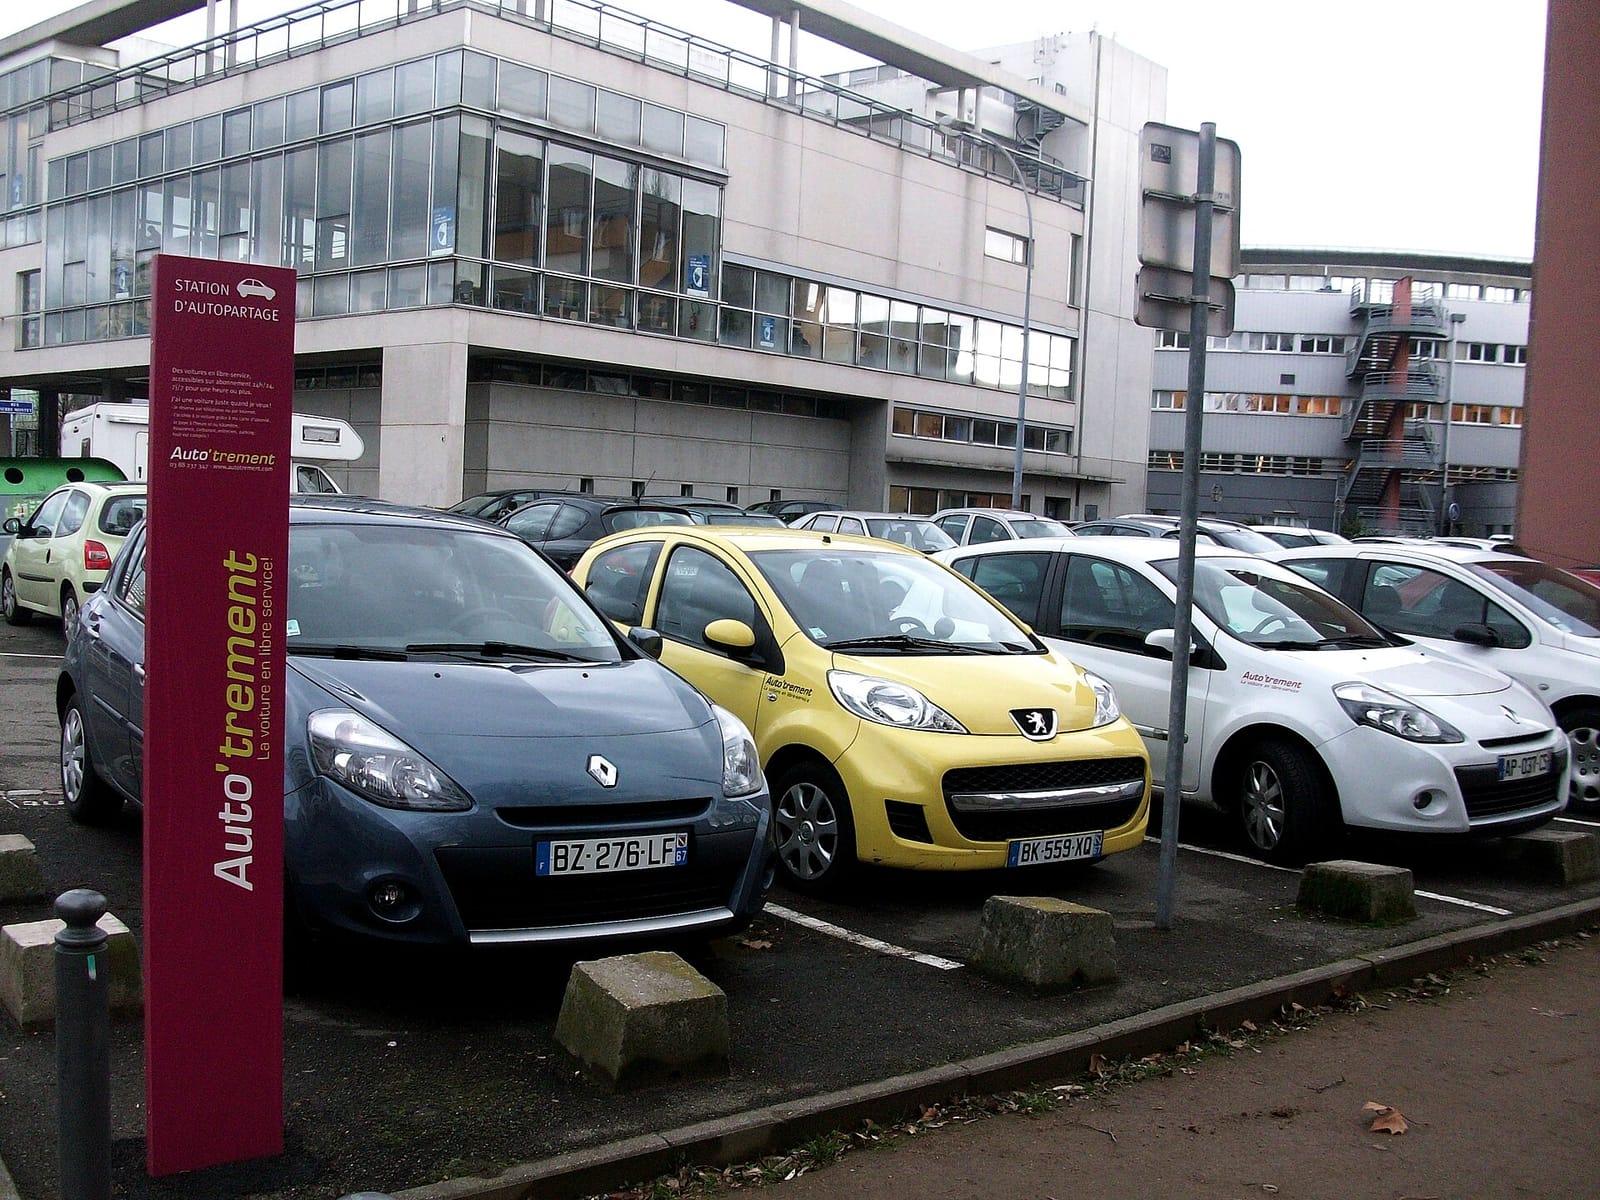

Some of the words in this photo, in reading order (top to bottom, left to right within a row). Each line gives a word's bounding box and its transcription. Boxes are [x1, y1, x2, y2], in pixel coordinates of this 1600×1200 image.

[175, 279, 230, 296] STATION
[174, 300, 280, 322] D'AUTOPARTAGE
[184, 368, 207, 376] voitures
[212, 386, 228, 394] heure
[215, 379, 251, 387] abonnement
[194, 397, 214, 405] voiture
[170, 446, 275, 465] Auto'trement
[259, 623, 272, 656] libre
[260, 661, 272, 679] en
[765, 676, 813, 697] Auto'trement
[1242, 671, 1303, 689] Auto'trement
[258, 684, 272, 737] voiture
[214, 550, 258, 891] Auto'trement
[257, 743, 270, 760] La
[553, 838, 675, 872] BZ-276-LF
[676, 850, 687, 862] 67
[1021, 837, 1092, 862] BK-559-XQ
